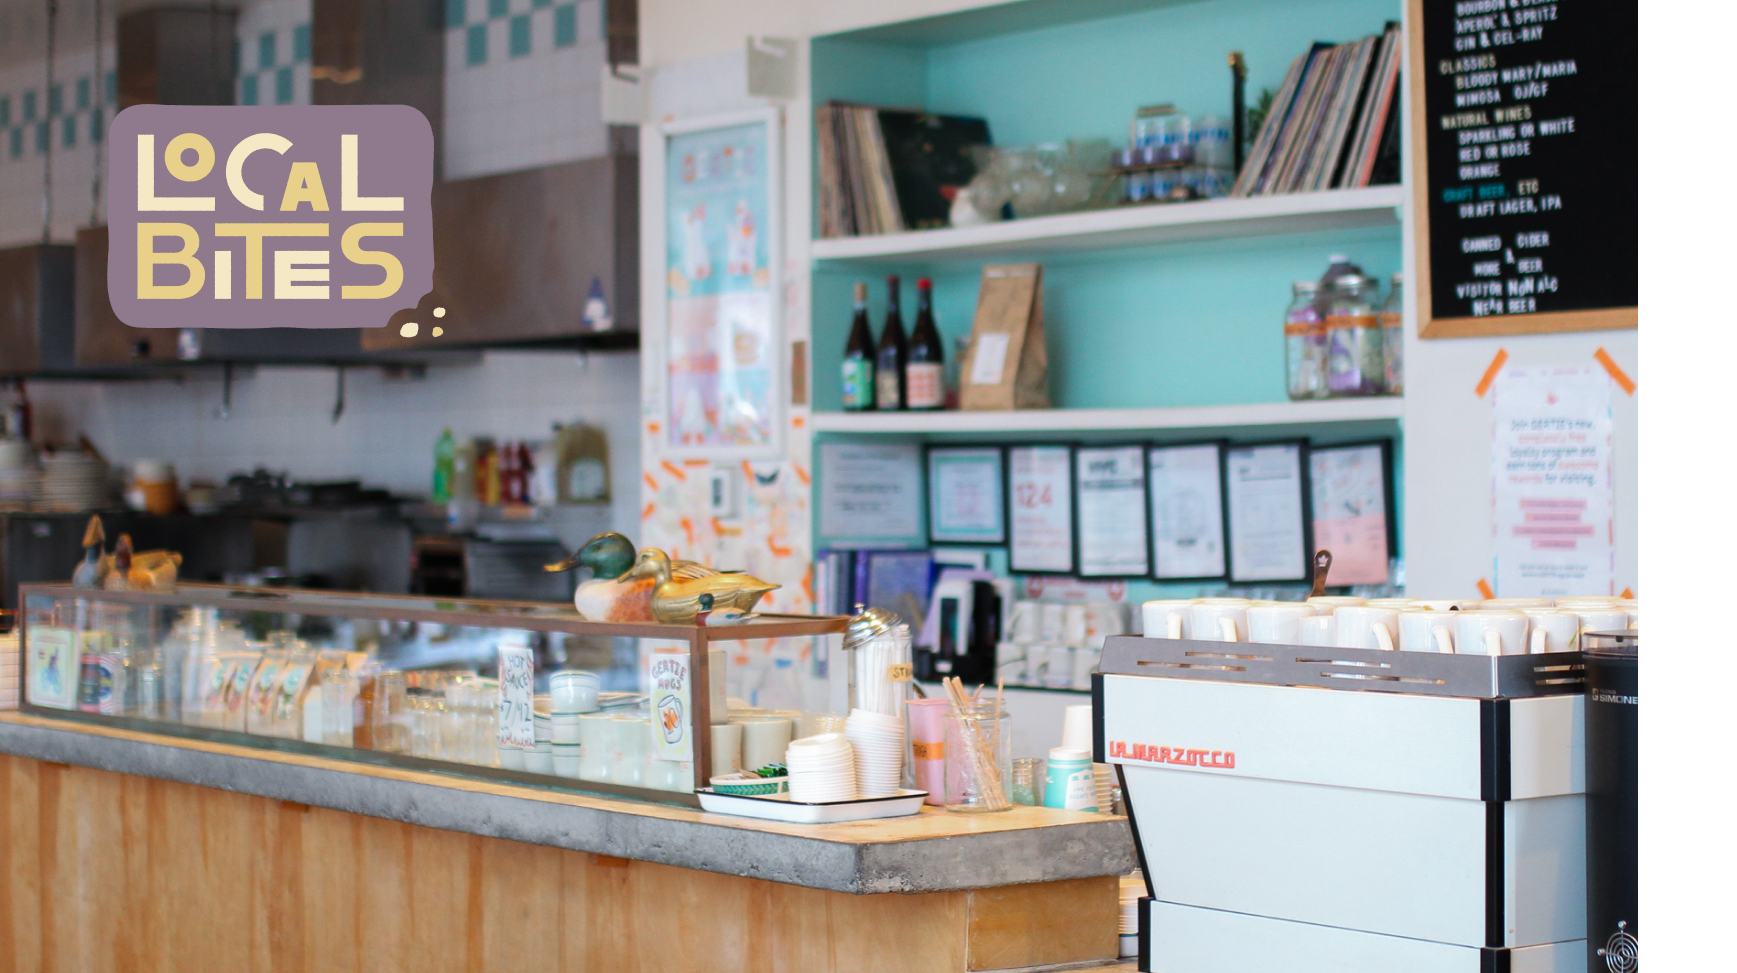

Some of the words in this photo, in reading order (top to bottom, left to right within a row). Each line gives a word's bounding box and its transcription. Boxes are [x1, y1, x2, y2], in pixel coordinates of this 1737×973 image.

[1456, 0, 1506, 16] BOURBON
[1501, 12, 1511, 27] &
[1515, 5, 1558, 25] SPRITZ
[1456, 36, 1476, 51] GIN
[1480, 31, 1491, 48] &
[1493, 26, 1543, 45] CEL-RAY
[1440, 54, 1497, 74] CLASSICS
[1457, 71, 1499, 89] BLOODY
[1456, 88, 1501, 107] MIMOSA
[1442, 112, 1489, 130] NATURAL
[1494, 105, 1532, 123] WINES
[1459, 125, 1516, 145] SPARKLING
[1520, 122, 1535, 138] OR
[1539, 116, 1575, 136] WHITE
[1459, 146, 1481, 162] RED
[1485, 144, 1499, 159] OR
[1501, 140, 1531, 158] ROSE
[1459, 163, 1501, 180] ORANGE
[1518, 178, 1539, 195] ETC
[1459, 201, 1496, 219] DRAFT
[1499, 197, 1538, 215] LAGER,
[1541, 194, 1562, 211] IPA
[1462, 235, 1502, 254] CANNED
[1517, 231, 1550, 249] CIDER
[1505, 248, 1516, 264] &
[1473, 261, 1501, 277] MORE
[1518, 257, 1543, 274] BEER
[1456, 281, 1502, 299] VISITOR
[1473, 298, 1504, 317] NEAR
[1508, 297, 1536, 314] BEER
[1016, 483, 1053, 508] 124
[508, 655, 525, 670] HOT
[652, 659, 687, 681] GERTIE
[658, 678, 682, 691] MUGS
[1600, 694, 1638, 704] SIMONE
[1110, 740, 1127, 758] LA
[1132, 743, 1235, 769] MARZOCCO
